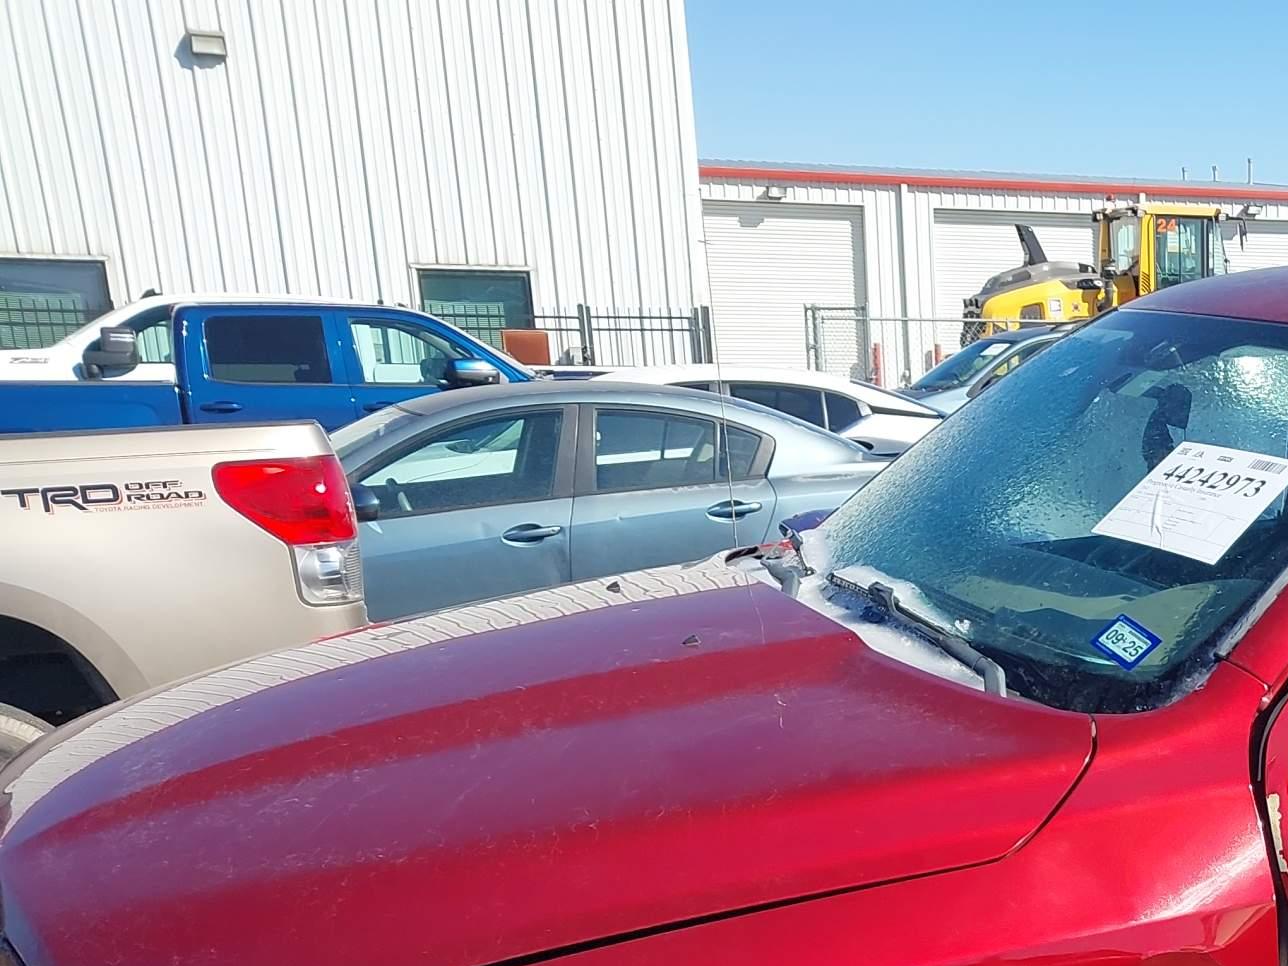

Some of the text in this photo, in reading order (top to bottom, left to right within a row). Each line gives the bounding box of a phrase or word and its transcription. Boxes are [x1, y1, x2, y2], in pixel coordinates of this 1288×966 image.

[1157, 218, 1177, 232] 24
[124, 480, 183, 492] OFF
[1163, 464, 1266, 498] 44242973
[0, 484, 121, 513] TRD
[126, 490, 206, 504] ROAD
[95, 505, 122, 513] TOYOTA
[1106, 629, 1125, 645] 09
[1121, 640, 1144, 657] 25
